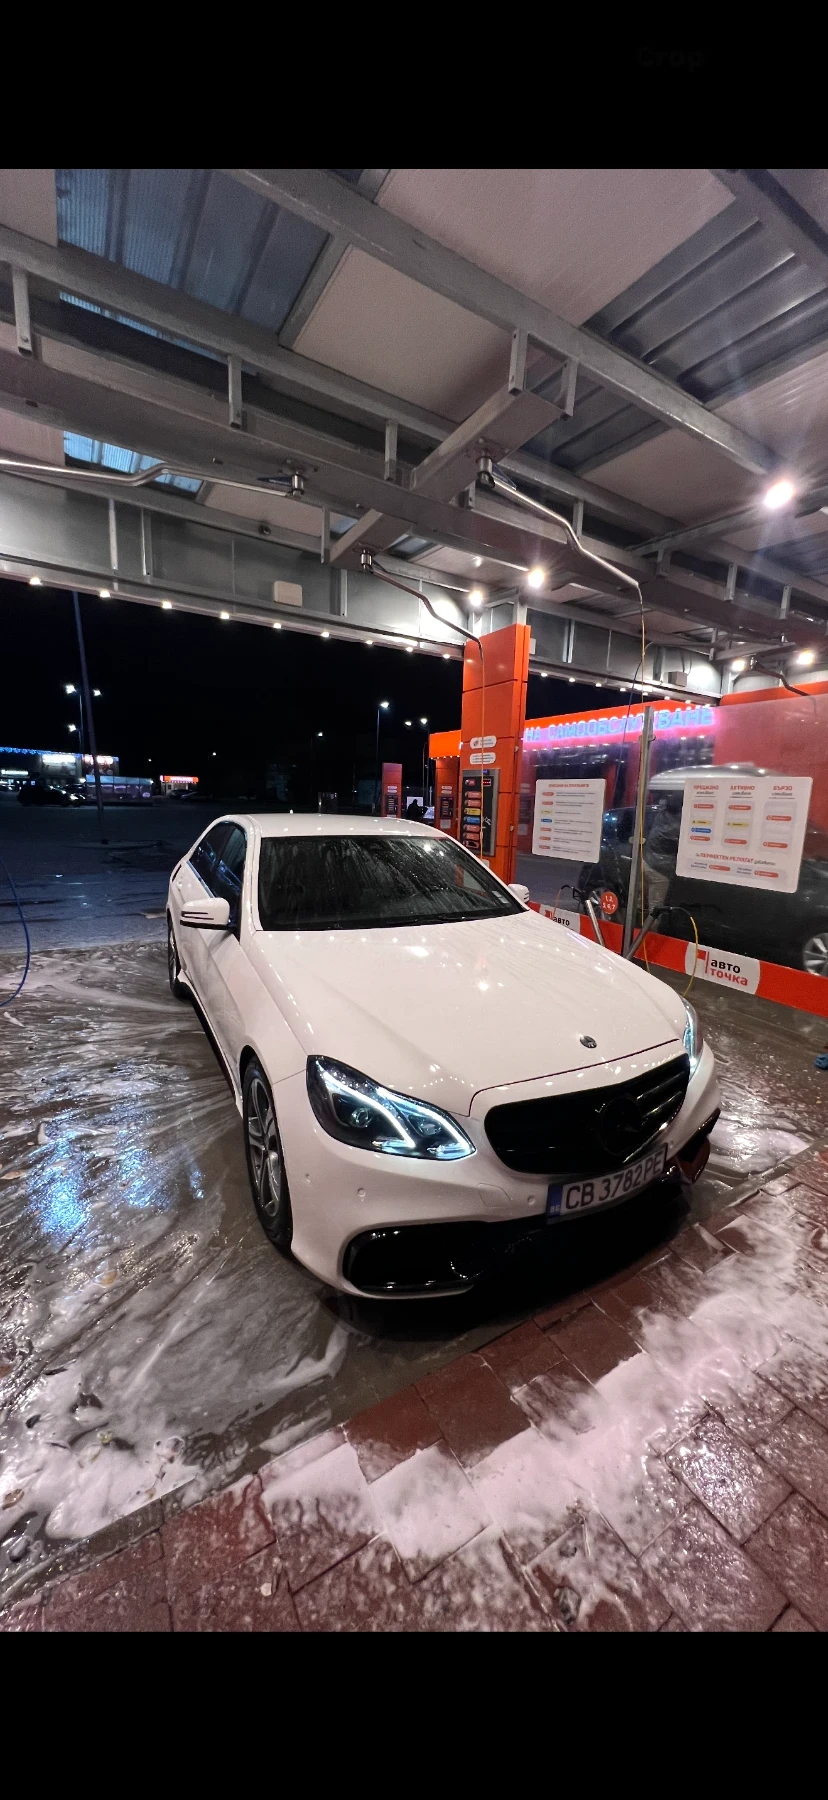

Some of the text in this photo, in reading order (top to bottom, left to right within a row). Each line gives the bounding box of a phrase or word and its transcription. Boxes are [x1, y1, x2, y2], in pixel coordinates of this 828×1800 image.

[553, 916, 570, 927] авто
[711, 959, 741, 974] авто
[710, 968, 749, 987] точка
